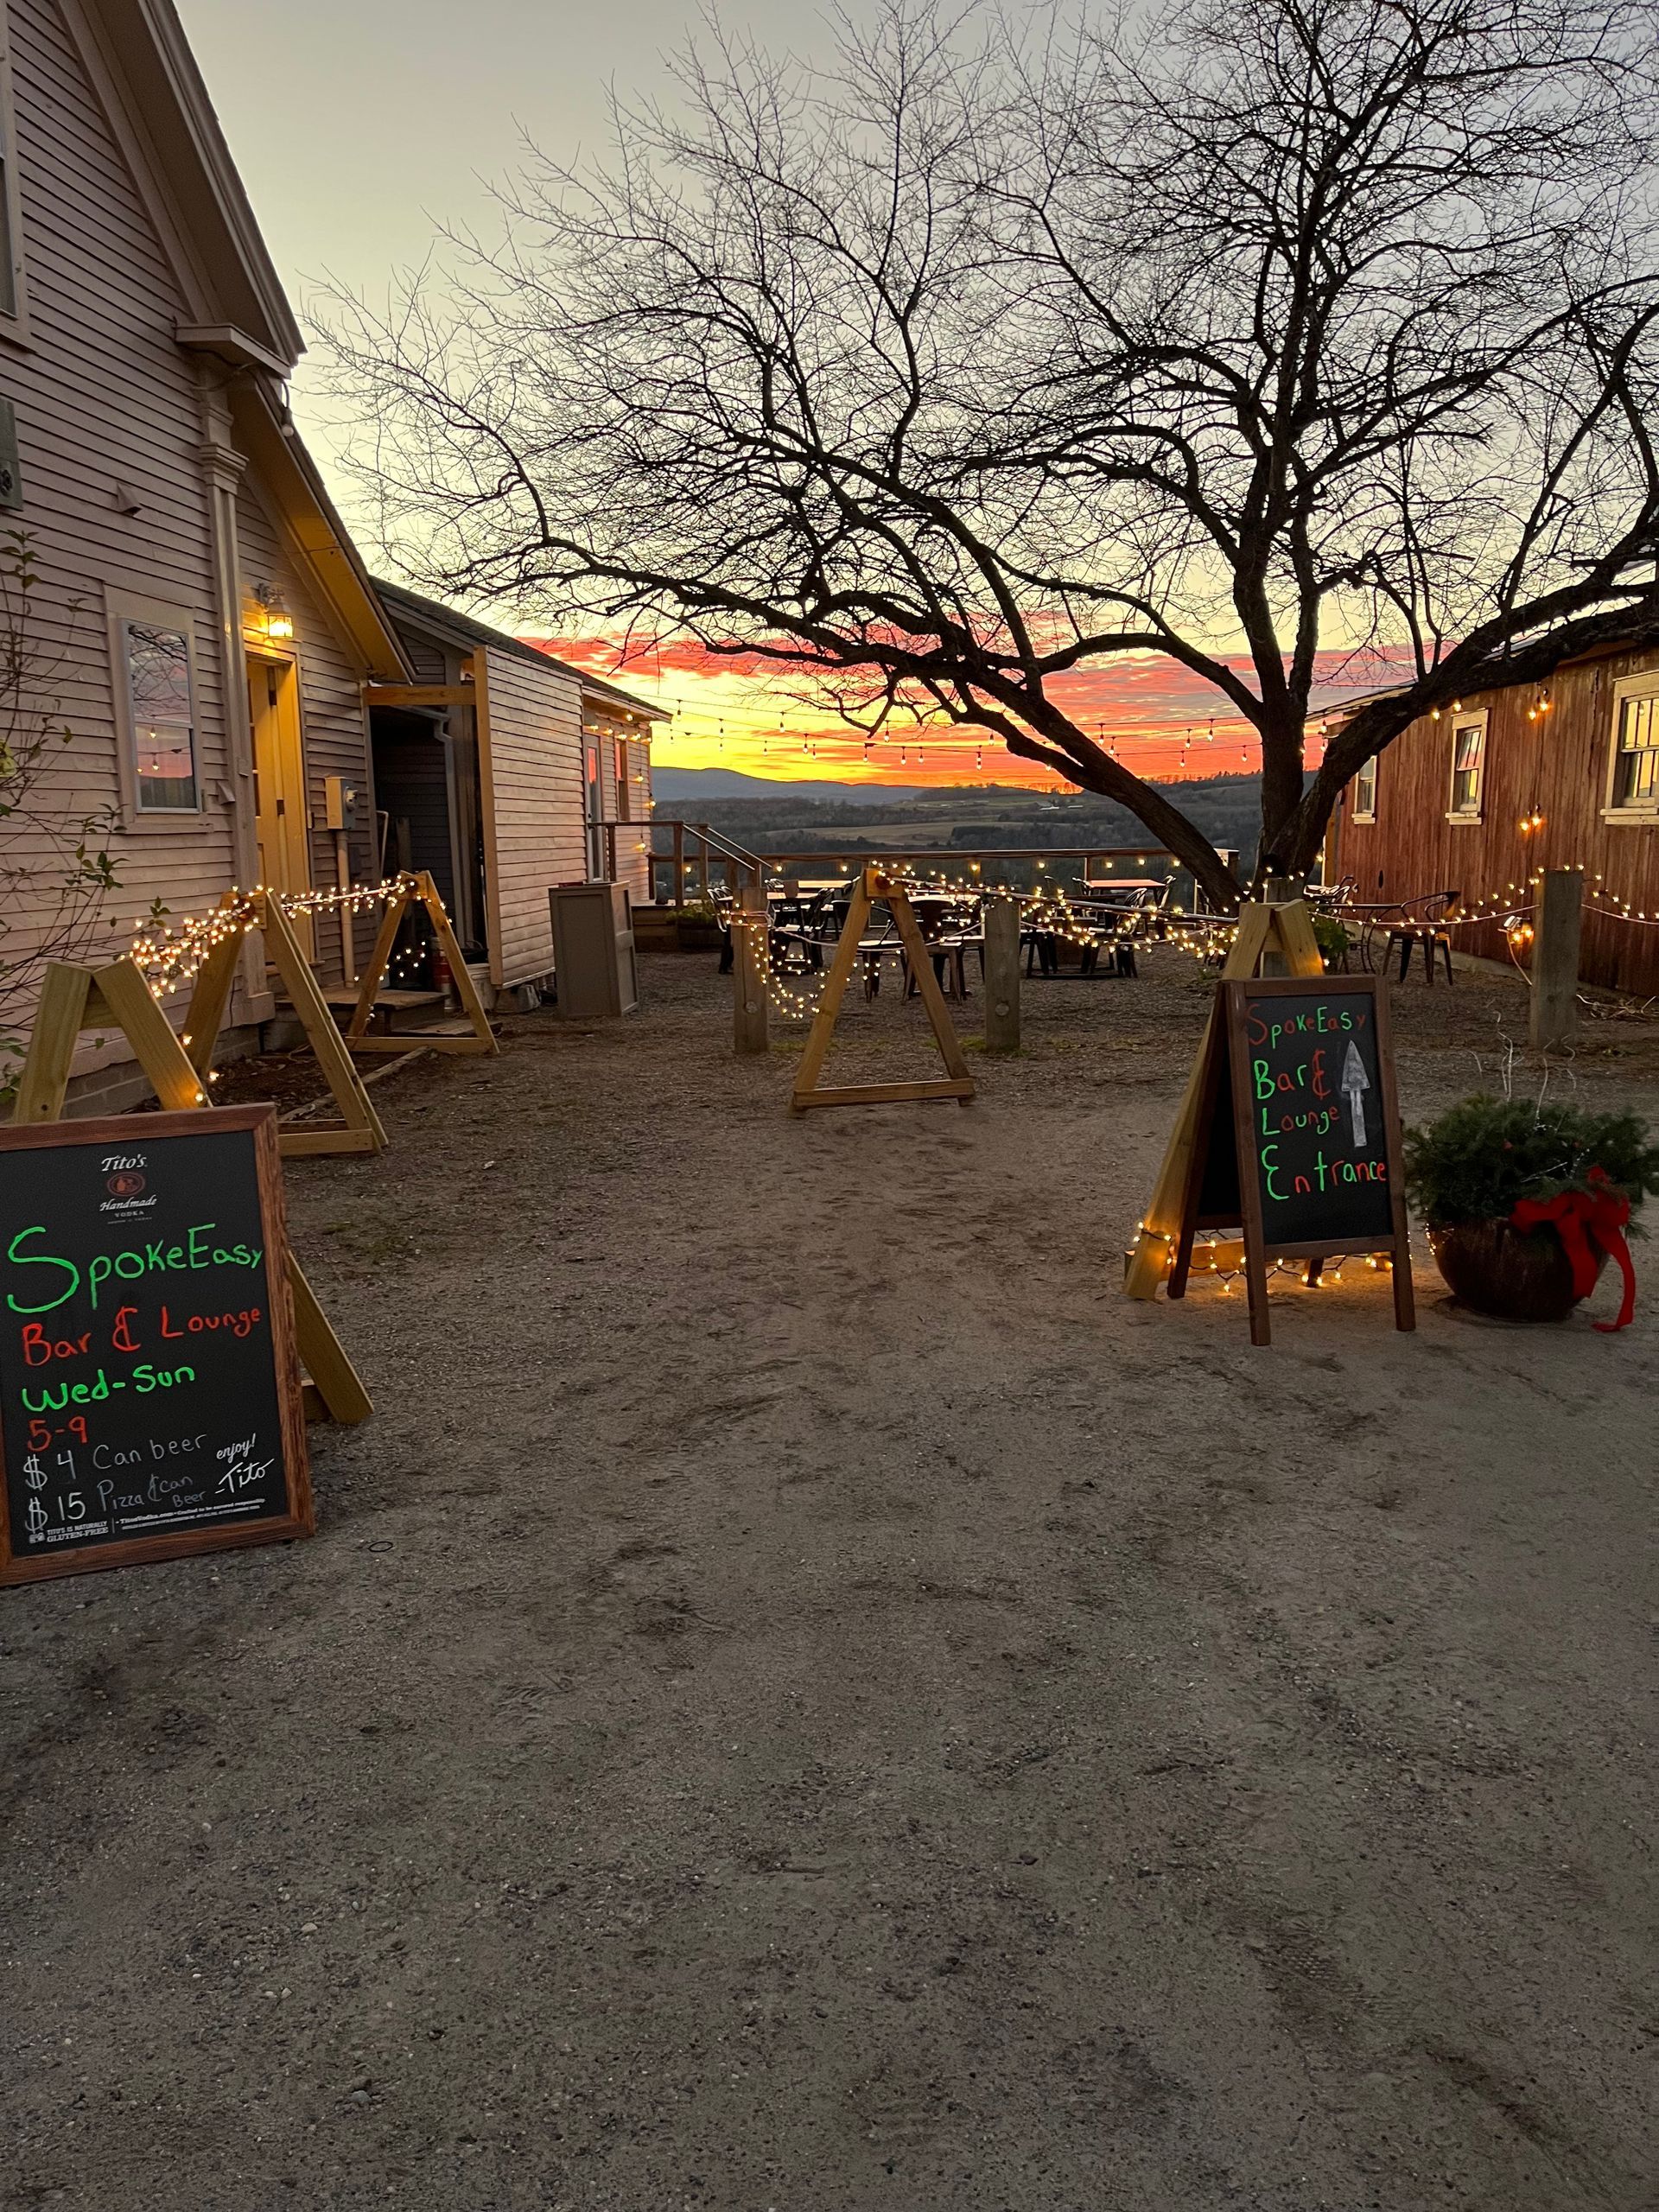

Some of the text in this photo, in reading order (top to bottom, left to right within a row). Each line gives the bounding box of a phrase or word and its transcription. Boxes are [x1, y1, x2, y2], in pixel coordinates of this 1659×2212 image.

[1247, 1003, 1366, 1050] SpokeEasy
[1254, 1059, 1307, 1100] Bar
[1262, 1106, 1340, 1135] Lounge
[101, 1154, 147, 1172] Tito's
[1261, 1144, 1387, 1200] Entrance
[99, 1194, 157, 1211] Handmade
[7, 1224, 264, 1313] SpokeEasy
[22, 1323, 92, 1366] Bar
[161, 1306, 261, 1337] Lounge
[22, 1365, 195, 1413] Wed-Sun
[28, 1415, 88, 1452] 5-9
[216, 1433, 256, 1464] enjoy!
[92, 1444, 142, 1469] Can
[149, 1434, 207, 1459] beer
[97, 1479, 145, 1511] Pizza
[159, 1476, 193, 1493] can
[173, 1491, 206, 1508] Beer
[47, 1527, 109, 1542] GLUTEN-FREE
[74, 1521, 108, 1531] NATURALLY
